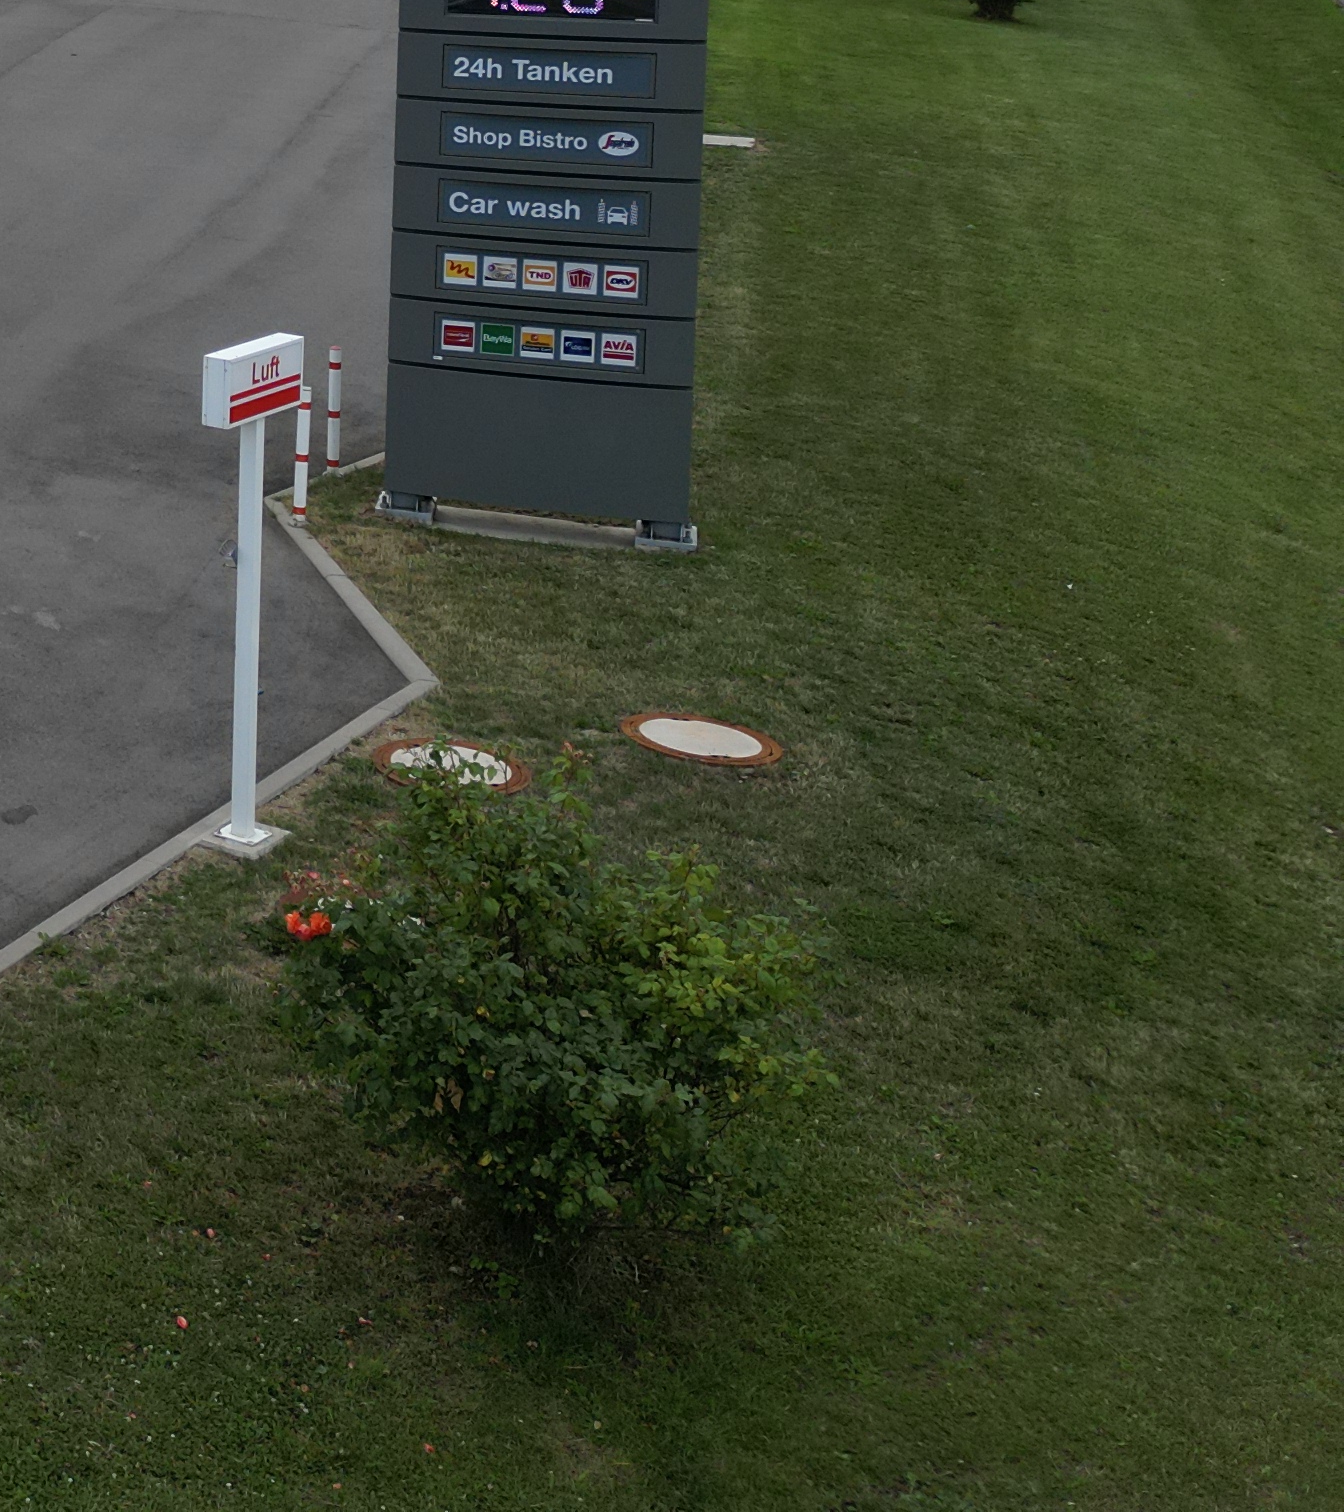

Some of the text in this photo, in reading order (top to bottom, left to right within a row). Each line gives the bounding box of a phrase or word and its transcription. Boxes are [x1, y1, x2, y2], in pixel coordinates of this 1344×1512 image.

[453, 56, 614, 85] 24h Tanken
[452, 125, 512, 150] Shop
[519, 129, 588, 151] Bistro
[448, 191, 581, 221] Car wash
[603, 339, 635, 353] AVIA
[252, 355, 281, 386] Luft
